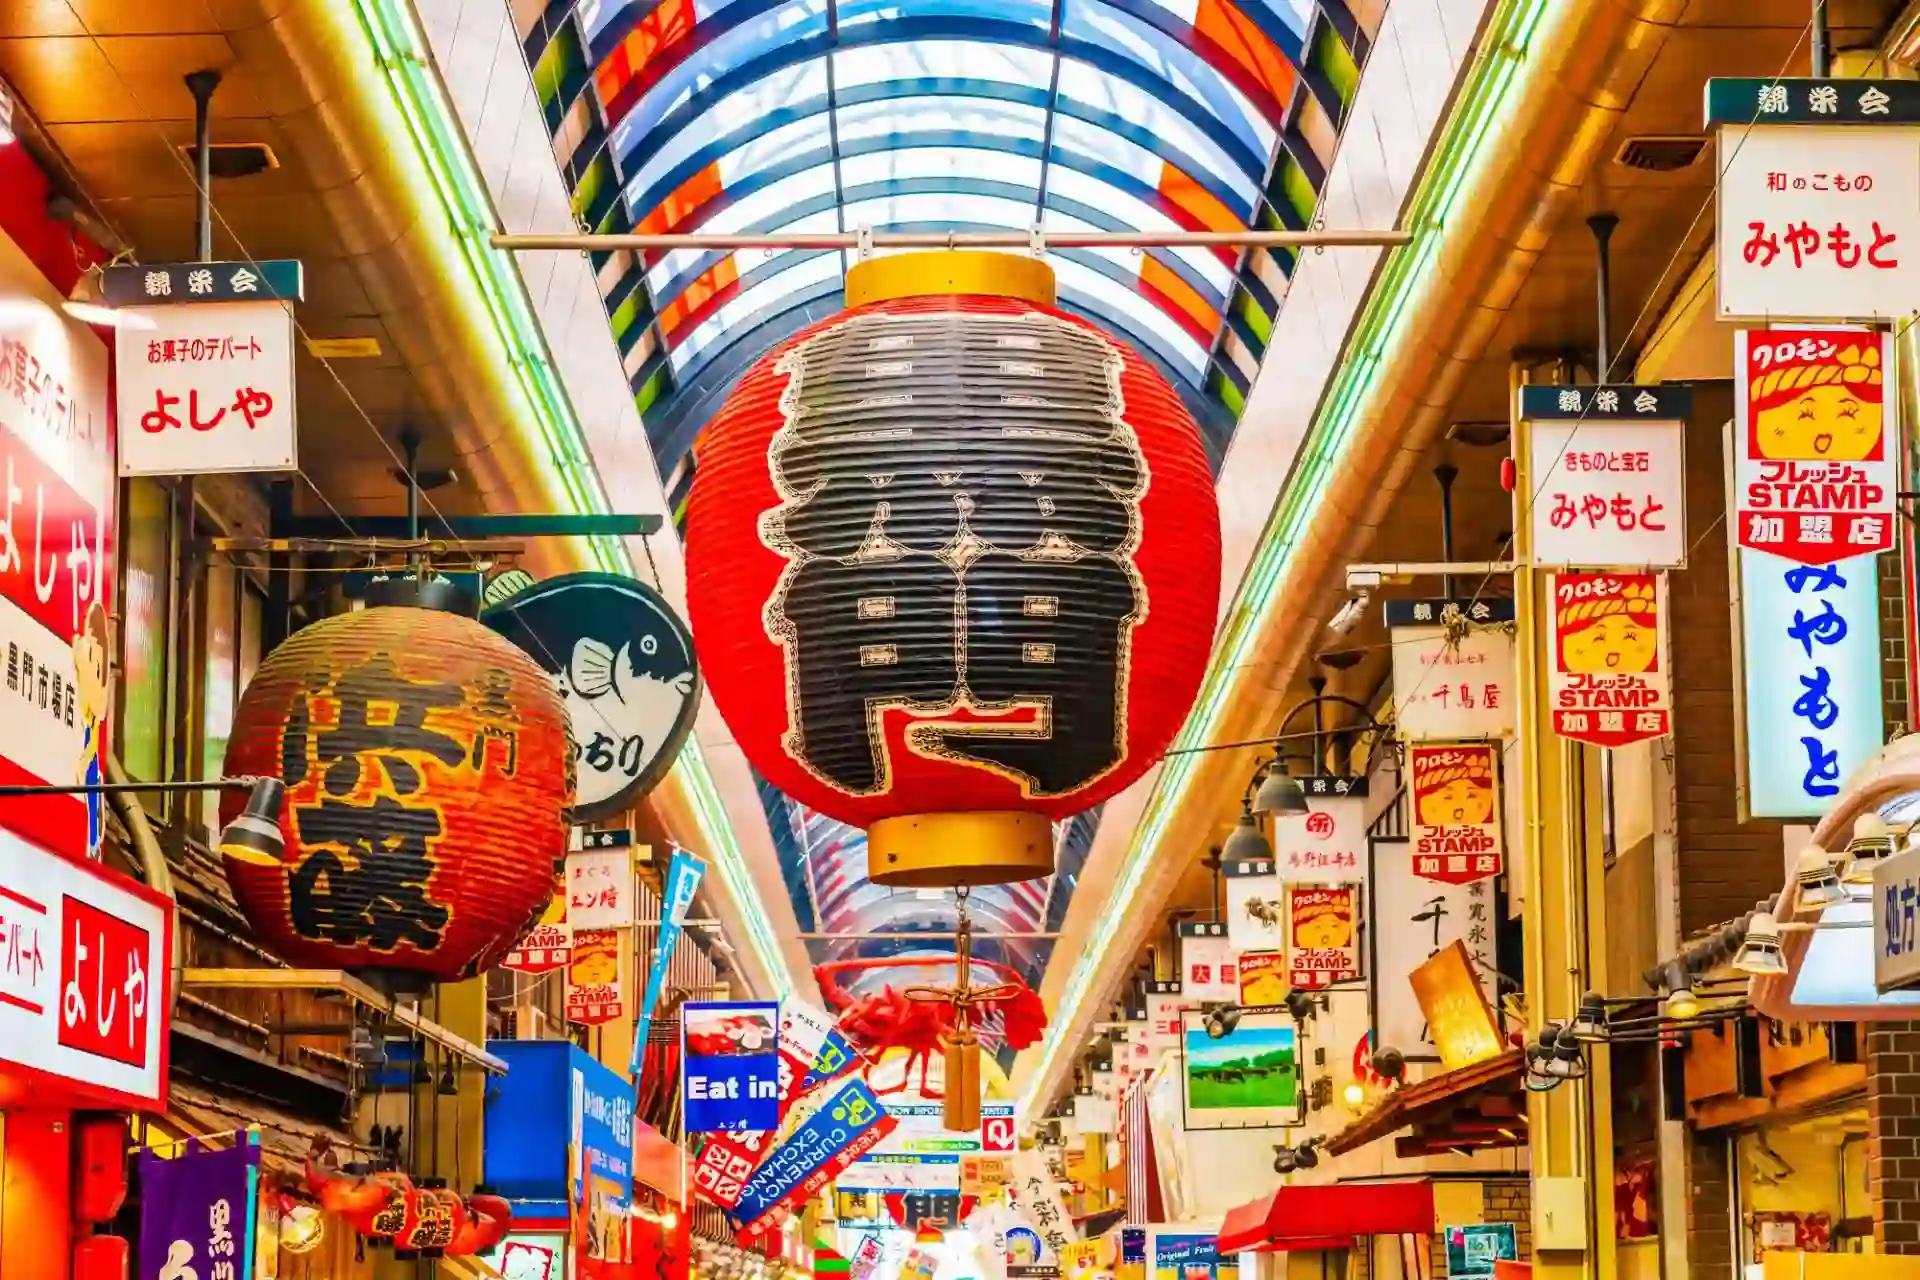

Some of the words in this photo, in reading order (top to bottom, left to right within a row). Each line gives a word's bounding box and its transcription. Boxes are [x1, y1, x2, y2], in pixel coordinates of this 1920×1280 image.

[1767, 171, 1873, 193] 和のこもの
[1743, 221, 1898, 269] みやもと
[147, 336, 262, 364] お菓子のデパート
[1752, 338, 1838, 369] クロモン
[141, 387, 273, 433] よしや
[1564, 451, 1650, 473] きものと宝石
[1760, 460, 1868, 484] フレッシュ
[1747, 483, 1884, 509] STAMP
[1549, 492, 1666, 531] みやもと
[1748, 513, 1884, 545] 加盟店
[757, 312, 1151, 798] 黒門
[1558, 578, 1622, 603] クロモン
[7, 641, 75, 729] 黒門市場店
[1567, 673, 1647, 689] フレッシュ
[1784, 564, 1848, 797] みやもと
[1559, 689, 1660, 708] STAMP
[1561, 711, 1661, 732] 加盟店
[1415, 753, 1464, 773] クロモン
[1423, 825, 1485, 838] フレッシュ
[1417, 837, 1495, 853] STAMP
[0, 915, 44, 986] パート
[1293, 957, 1352, 968] STAMP
[64, 918, 145, 1049] よしや
[687, 1075, 740, 1100] Eat
[749, 1075, 777, 1099] in
[758, 1128, 846, 1208] CURRENCY
